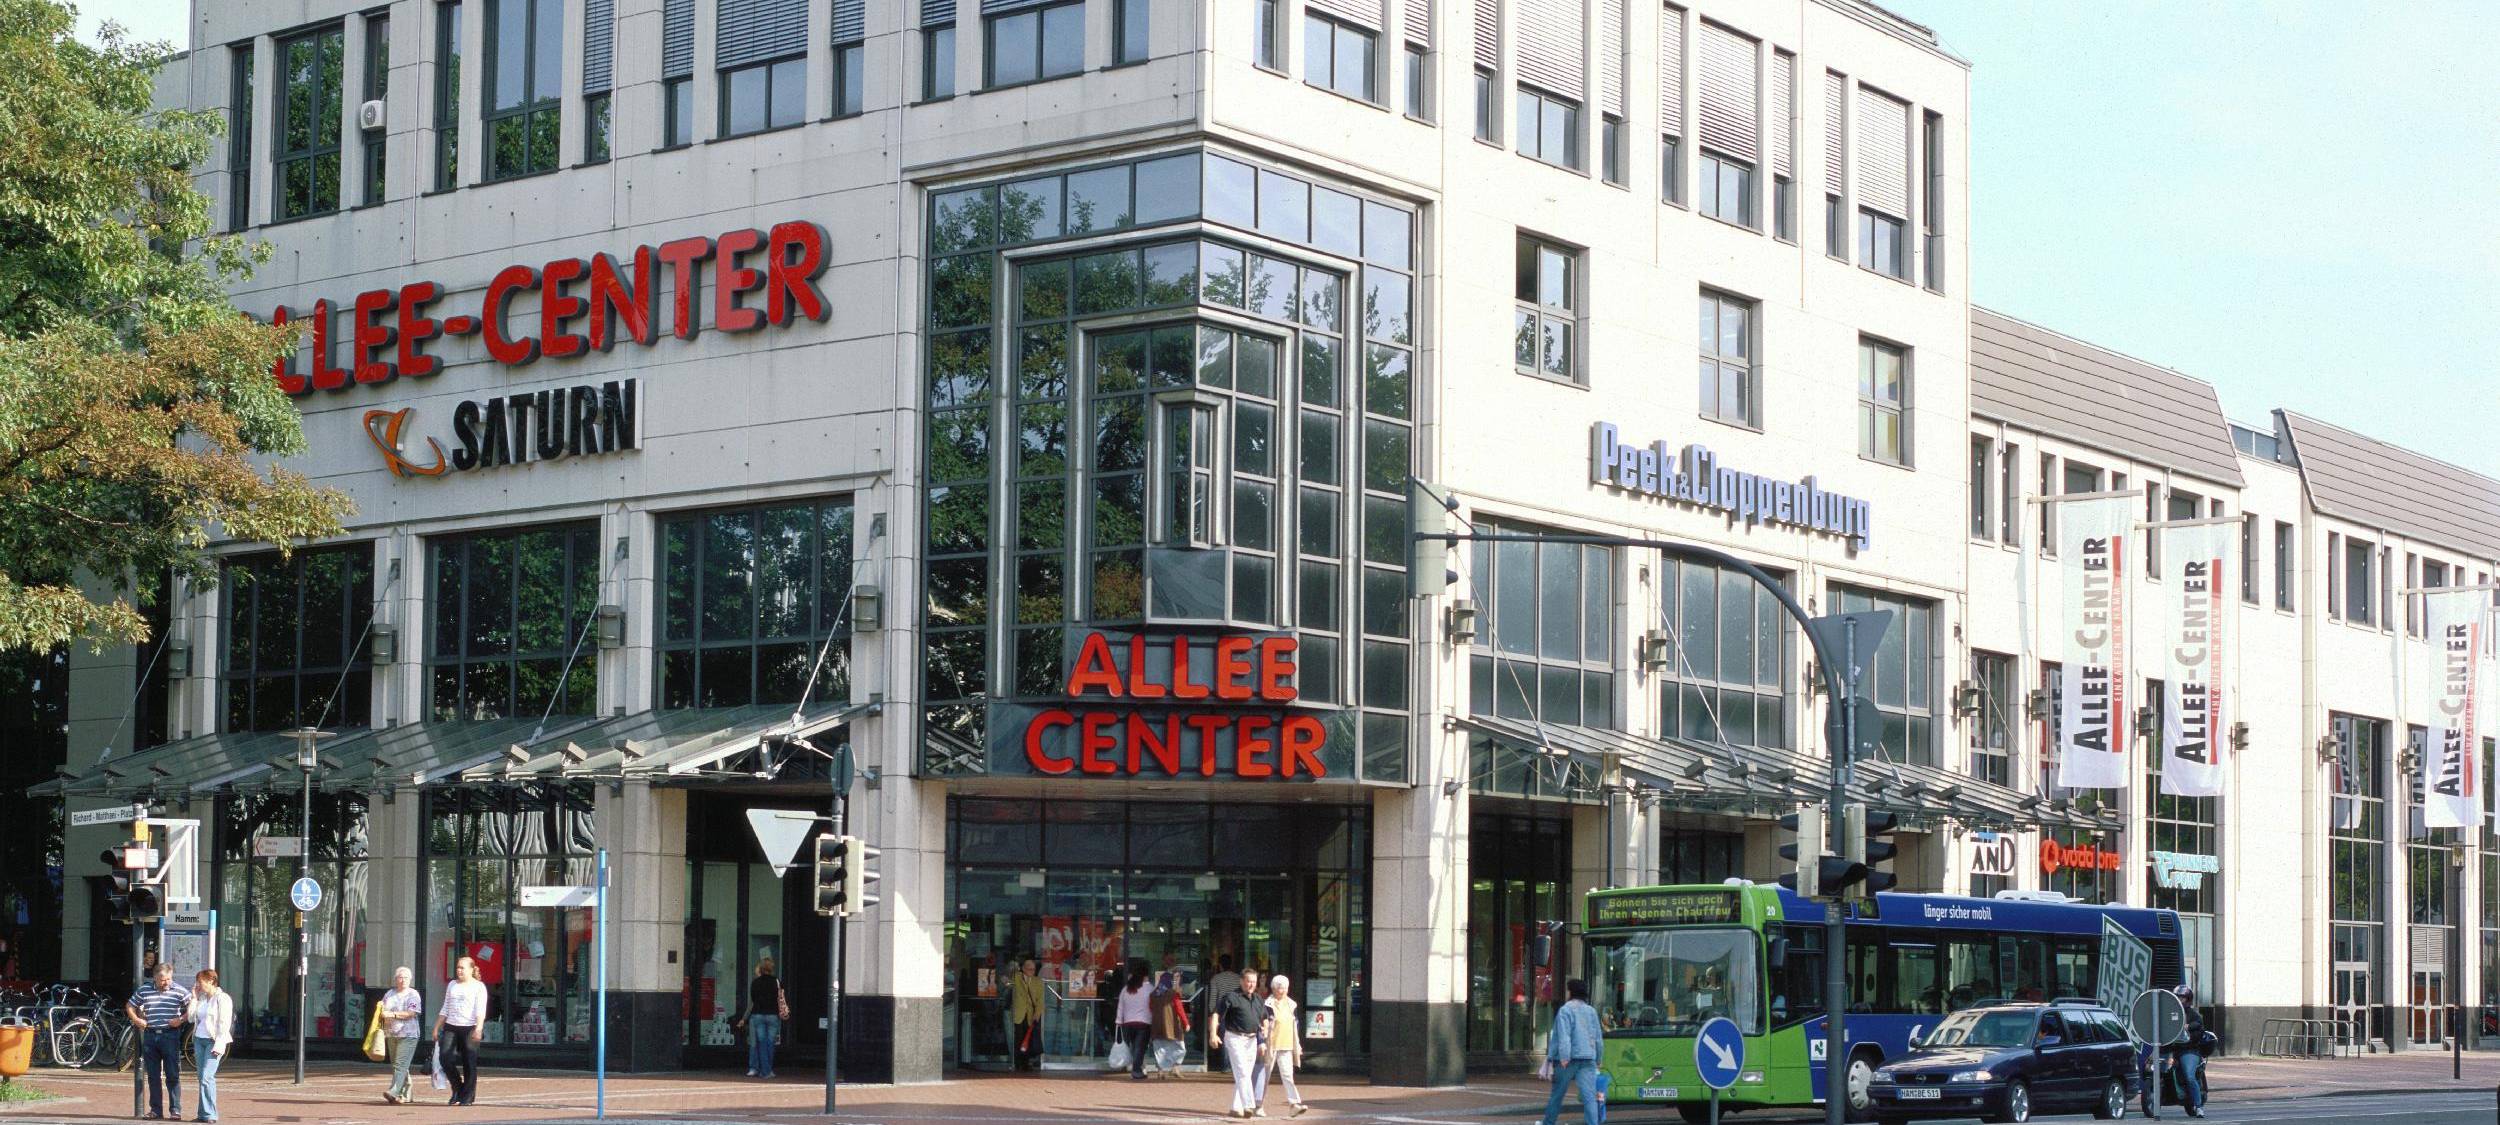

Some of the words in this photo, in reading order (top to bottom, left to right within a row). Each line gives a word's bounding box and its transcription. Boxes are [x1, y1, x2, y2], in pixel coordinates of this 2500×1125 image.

[241, 220, 832, 396] LLEE-CENTER
[452, 378, 643, 472] SATURN
[1068, 632, 1298, 700] ALLEE
[2074, 537, 2108, 752] ALLEE-CENTER
[2175, 561, 2207, 764] ALLEE-CENTER
[1025, 709, 1327, 778] CENTER
[2434, 623, 2468, 797] ALLEE-CENTER
[2062, 844, 2121, 870] vodaone
[1924, 903, 1948, 922] länger
[1949, 904, 1970, 919] sicher
[1972, 906, 1992, 920] mobil
[2107, 933, 2146, 985] BUS
